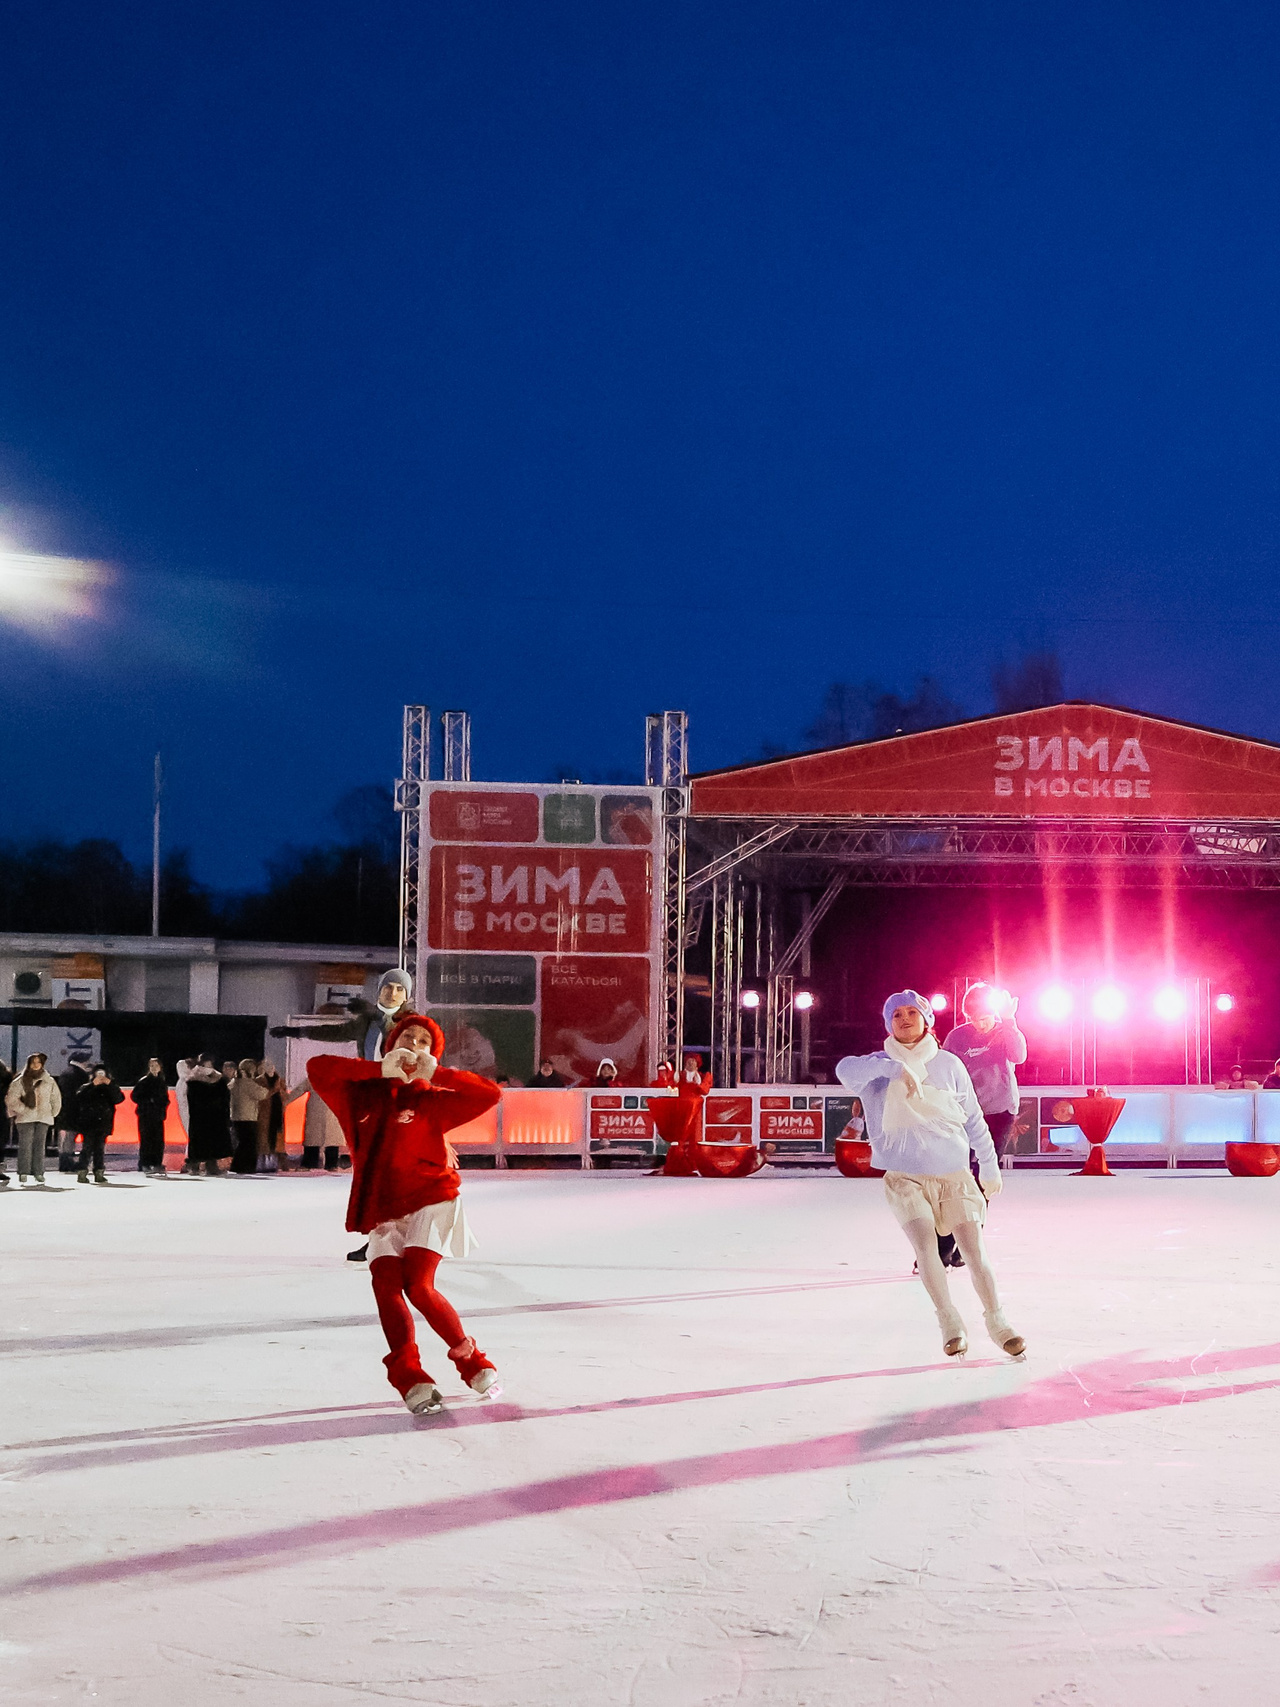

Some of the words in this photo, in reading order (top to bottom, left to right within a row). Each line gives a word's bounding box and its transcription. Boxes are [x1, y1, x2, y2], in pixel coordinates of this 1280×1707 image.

[994, 735, 1150, 773] ЗИМА
[994, 776, 1014, 797] В
[1024, 777, 1151, 799] МОСКВЕ
[454, 864, 628, 905] ЗИМА
[453, 910, 475, 932] В
[486, 911, 627, 934] МОСКВЕ
[550, 964, 578, 974] ВСЕ
[598, 1115, 647, 1127] ЗИМА
[768, 1116, 815, 1127] ЗИМА
[607, 1127, 646, 1135] МОСКВЕ
